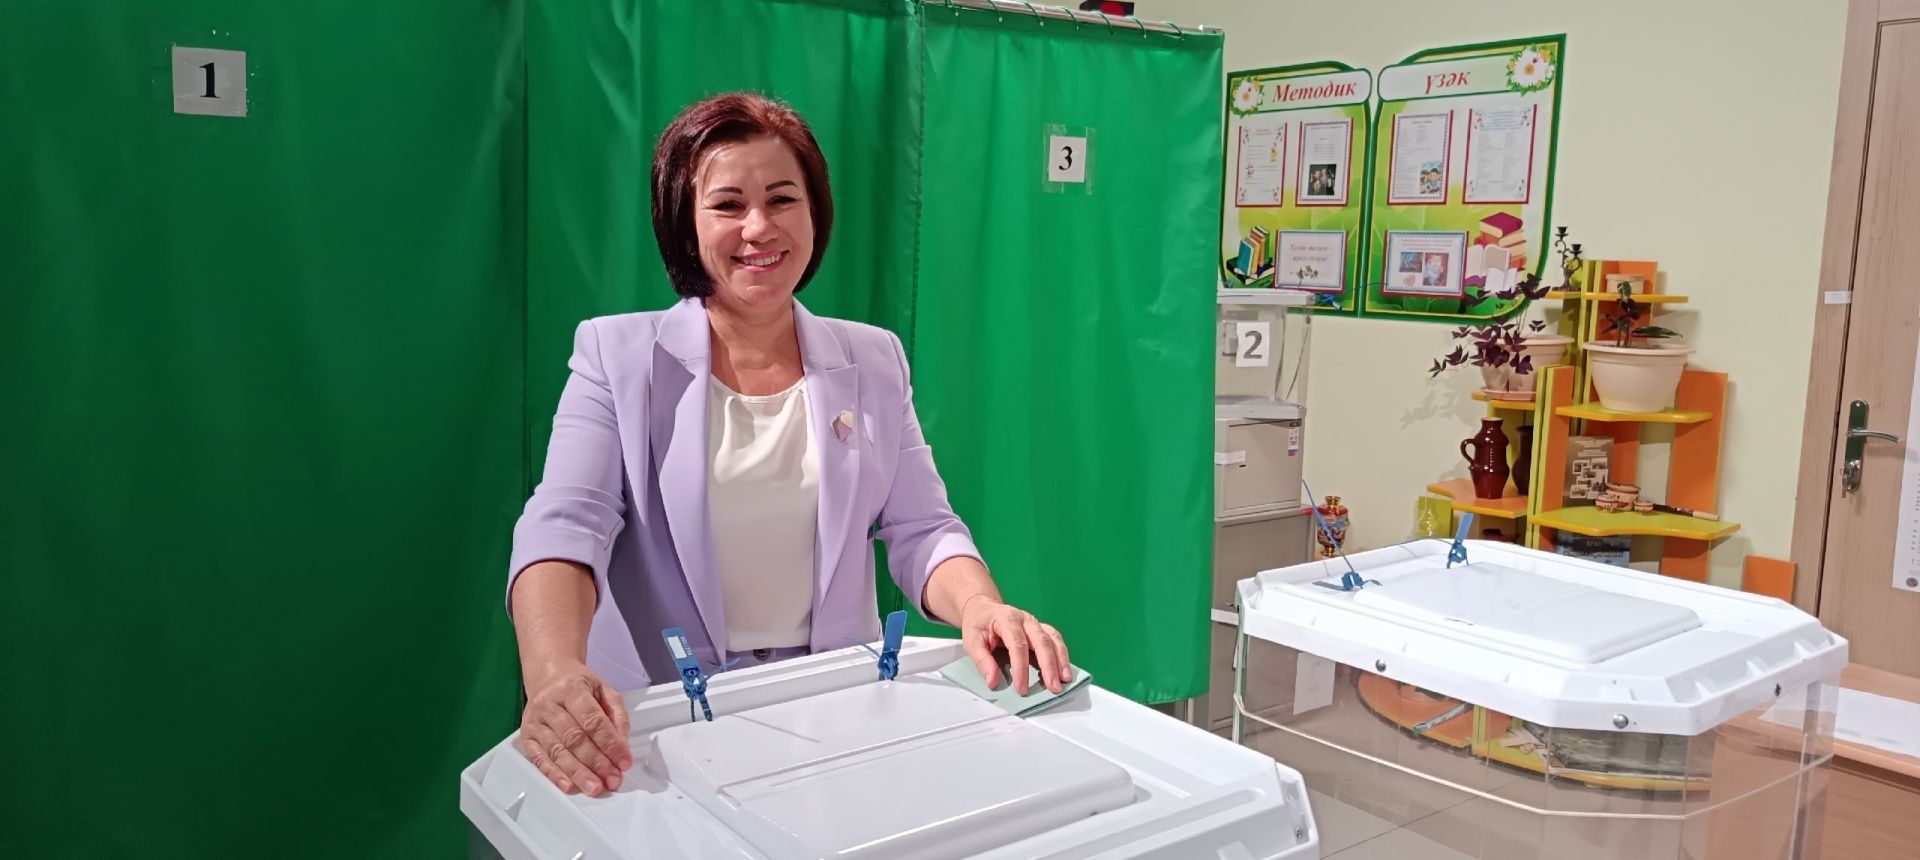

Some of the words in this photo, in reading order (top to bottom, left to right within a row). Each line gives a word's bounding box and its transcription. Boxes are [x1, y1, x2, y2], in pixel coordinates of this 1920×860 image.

[199, 62, 221, 99] 1
[1273, 80, 1357, 103] Методик
[1424, 71, 1471, 96] үзәк
[1059, 145, 1073, 171] 3
[1244, 330, 1262, 359] 2
